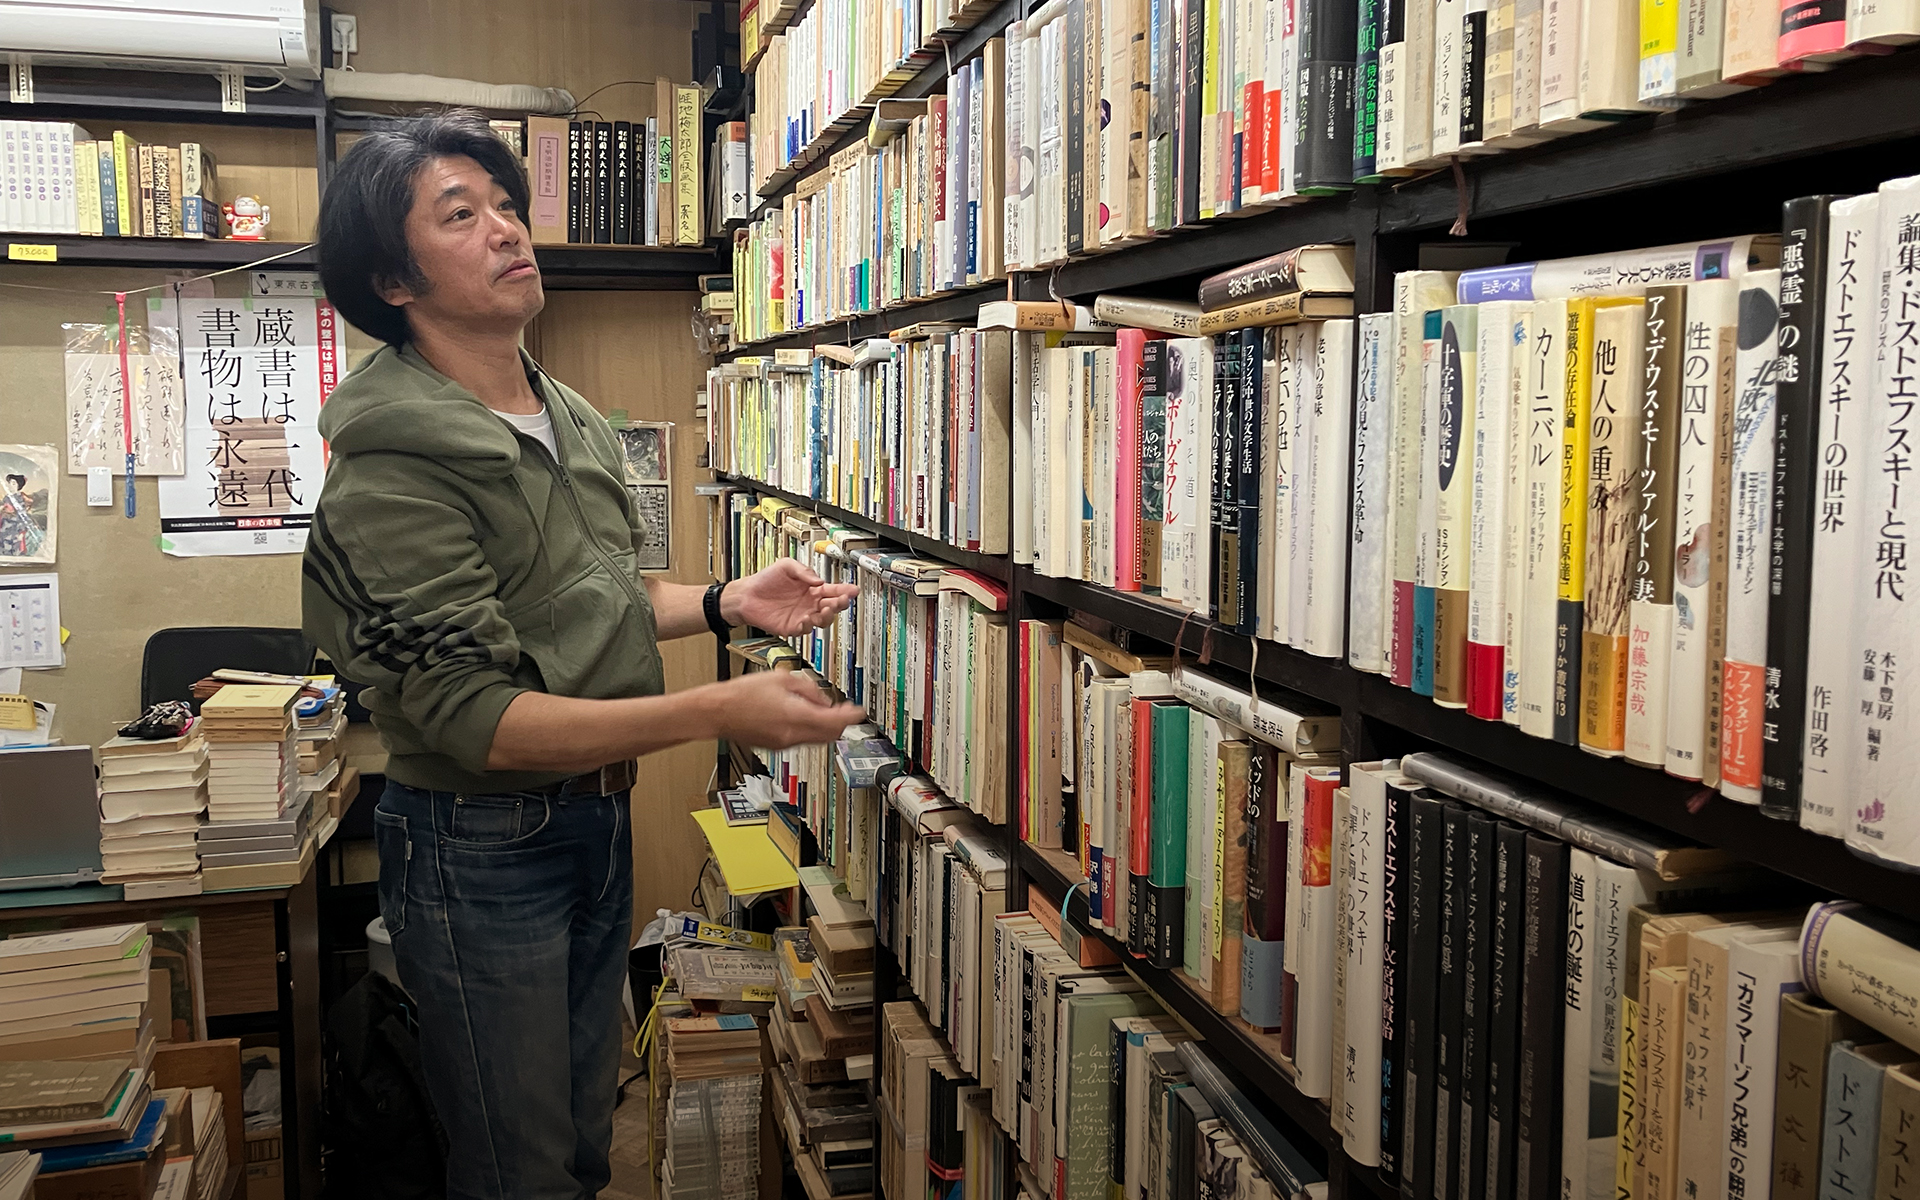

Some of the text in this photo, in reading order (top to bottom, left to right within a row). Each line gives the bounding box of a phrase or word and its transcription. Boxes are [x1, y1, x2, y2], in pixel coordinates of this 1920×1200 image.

[1072, 12, 1081, 116] ランボー全集
[1187, 11, 1198, 94] 黒い本
[320, 308, 334, 396] 本の整理は当店に
[1777, 228, 1807, 383] 『悪霊』の謎
[196, 307, 250, 508] 書物は永遠
[253, 308, 303, 508] 蔵書は一代
[1242, 345, 1255, 474] フランス中世の文学生活
[1314, 337, 1326, 417] 老いの意味
[1439, 343, 1455, 468] 十字軍の歴史
[1530, 327, 1554, 467] カーニバル
[1565, 312, 1580, 429] 遊戯の存在論
[1820, 229, 1862, 533] ドストエフスキーの世界
[1875, 212, 1920, 601] 論集・ドストエフスキーと現代
[1164, 398, 1182, 526] ボーヴォワール
[1224, 384, 1234, 487] ユダヤ人の歴史
[1636, 296, 1666, 603] アマデウス・モーツァルトの妻
[1680, 322, 1712, 580] 性の囚人 ノーマン・メイラー
[238, 518, 282, 528] 日本の古本屋
[1630, 624, 1650, 716] 加藤宗哉
[1734, 669, 1750, 766] ファンタジーと
[1763, 666, 1781, 742] 清水 正
[1808, 685, 1832, 774] 作田啓一
[1877, 651, 1897, 721] 木下豊房
[1357, 807, 1371, 965] ドストエフスキー
[1382, 798, 1397, 1041] ドストエフスキー&宮沢賢治
[1566, 873, 1585, 1011] 道化の誕生
[1698, 962, 1713, 1121] ドストエフスキー
[1828, 1073, 1861, 1200] ドストエ
[1890, 1107, 1913, 1200] ドスト
